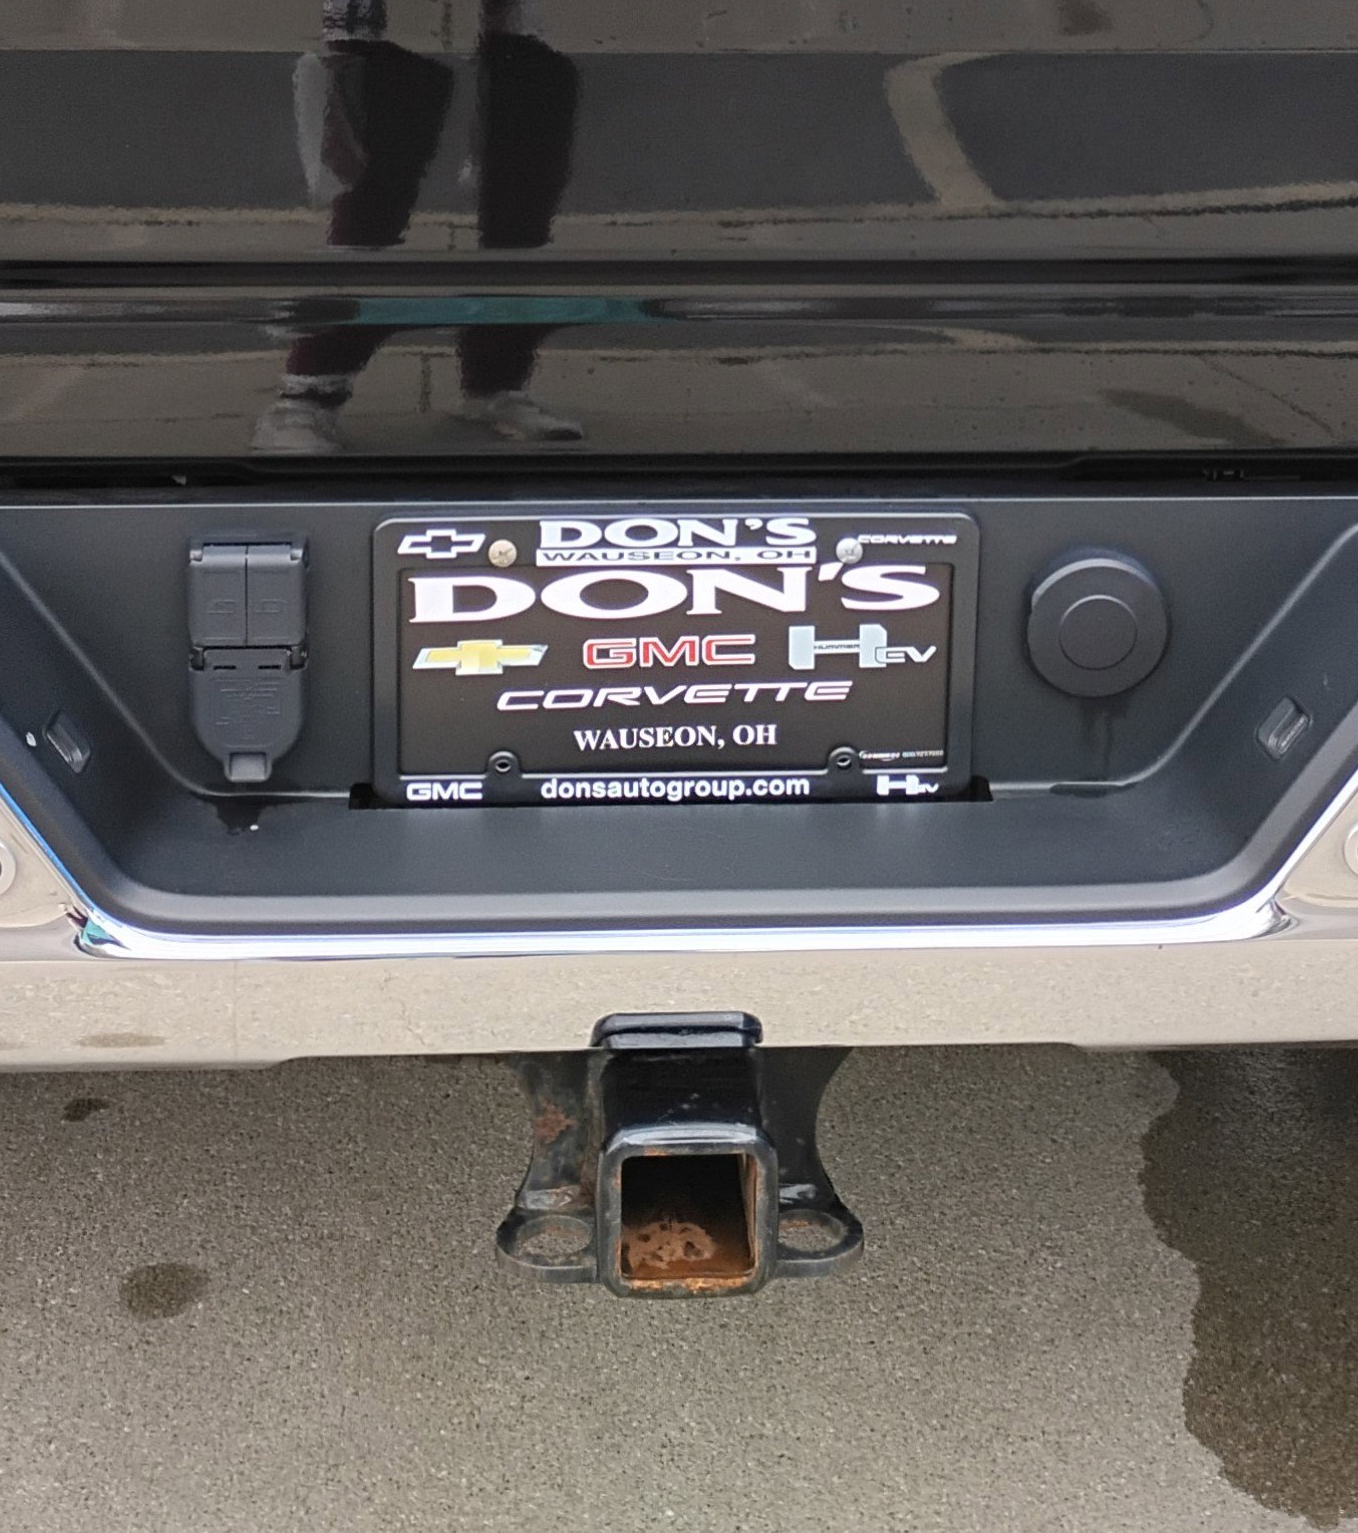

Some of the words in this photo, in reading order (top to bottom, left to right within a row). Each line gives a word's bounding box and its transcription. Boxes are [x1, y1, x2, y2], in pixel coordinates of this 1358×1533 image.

[540, 518, 817, 548] DON'S
[857, 534, 957, 545] CORVETTE
[543, 549, 742, 562] WAUSEON,
[757, 549, 811, 560] OH
[408, 562, 940, 623] DON'S
[583, 634, 756, 669] GMC
[497, 681, 853, 711] CORVETTE
[573, 725, 725, 751] WAUSEON,
[733, 724, 778, 745] OH
[406, 781, 483, 801] GMC
[540, 778, 810, 802] donsautogroup.com
